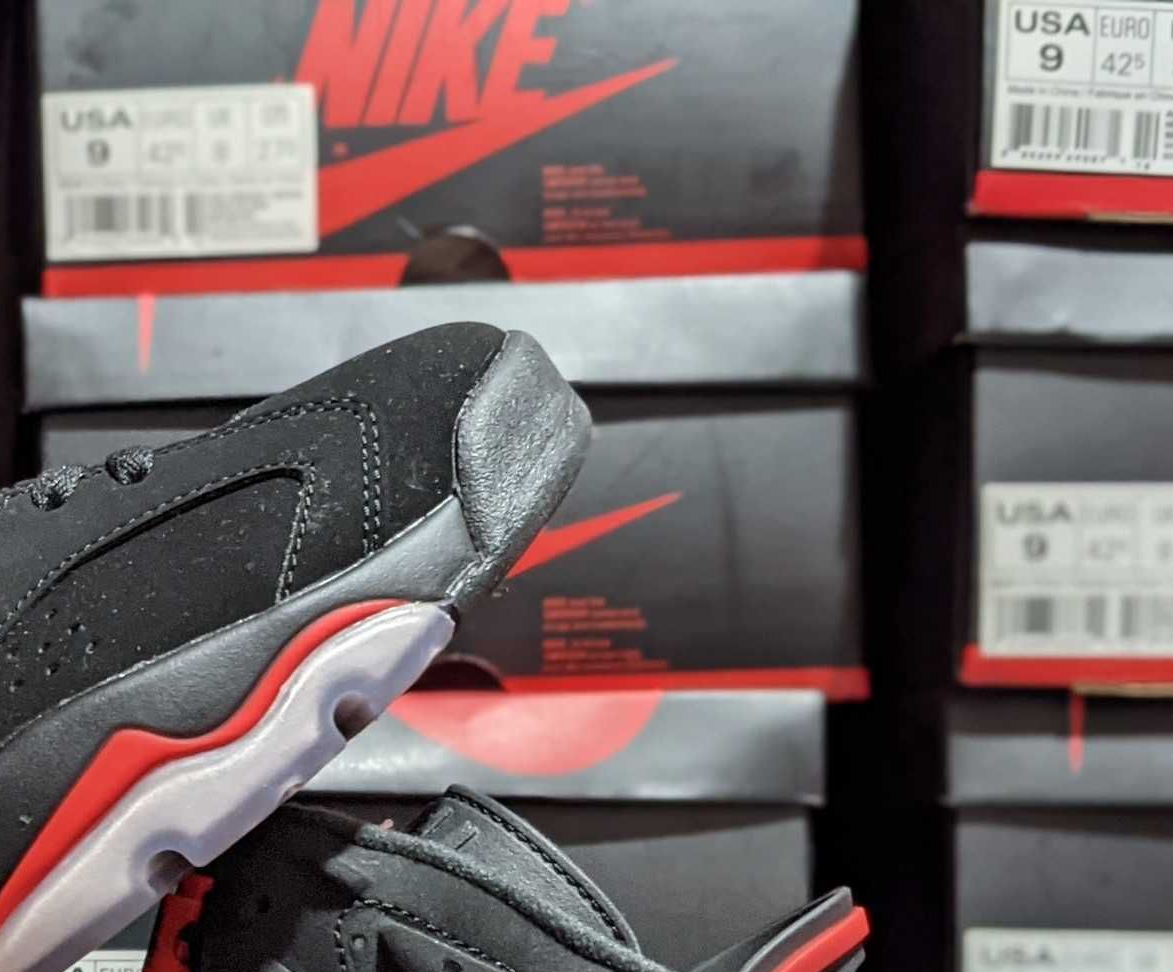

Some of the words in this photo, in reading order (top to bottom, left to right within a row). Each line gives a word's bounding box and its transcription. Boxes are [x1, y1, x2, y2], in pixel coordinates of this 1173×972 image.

[1014, 10, 1090, 36] USA
[1099, 16, 1150, 40] EURO
[292, 0, 571, 128] NIKE
[1039, 43, 1064, 72] 9
[60, 108, 131, 132] USA
[86, 139, 111, 167] 9
[997, 503, 1073, 526] USA
